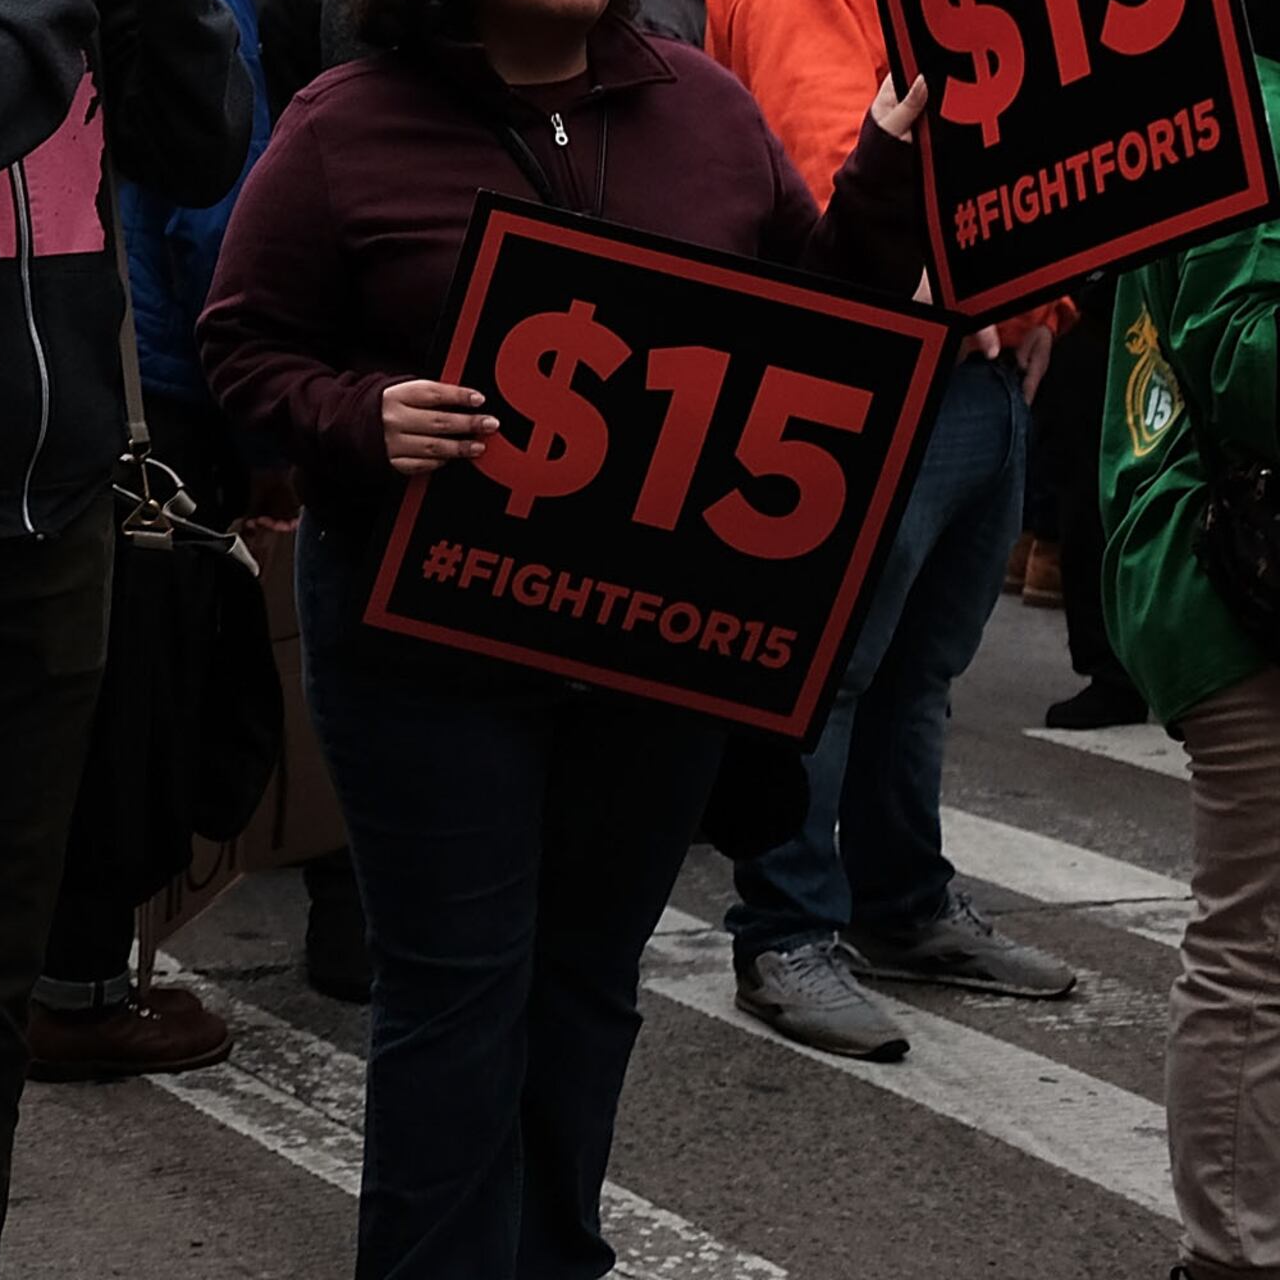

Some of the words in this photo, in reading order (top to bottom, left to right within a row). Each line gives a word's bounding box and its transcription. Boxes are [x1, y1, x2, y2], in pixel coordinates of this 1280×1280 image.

[953, 98, 1221, 250] #FIGHTFOR15
[473, 299, 874, 561] $15
[420, 538, 799, 671] #FIGHTFOR15
